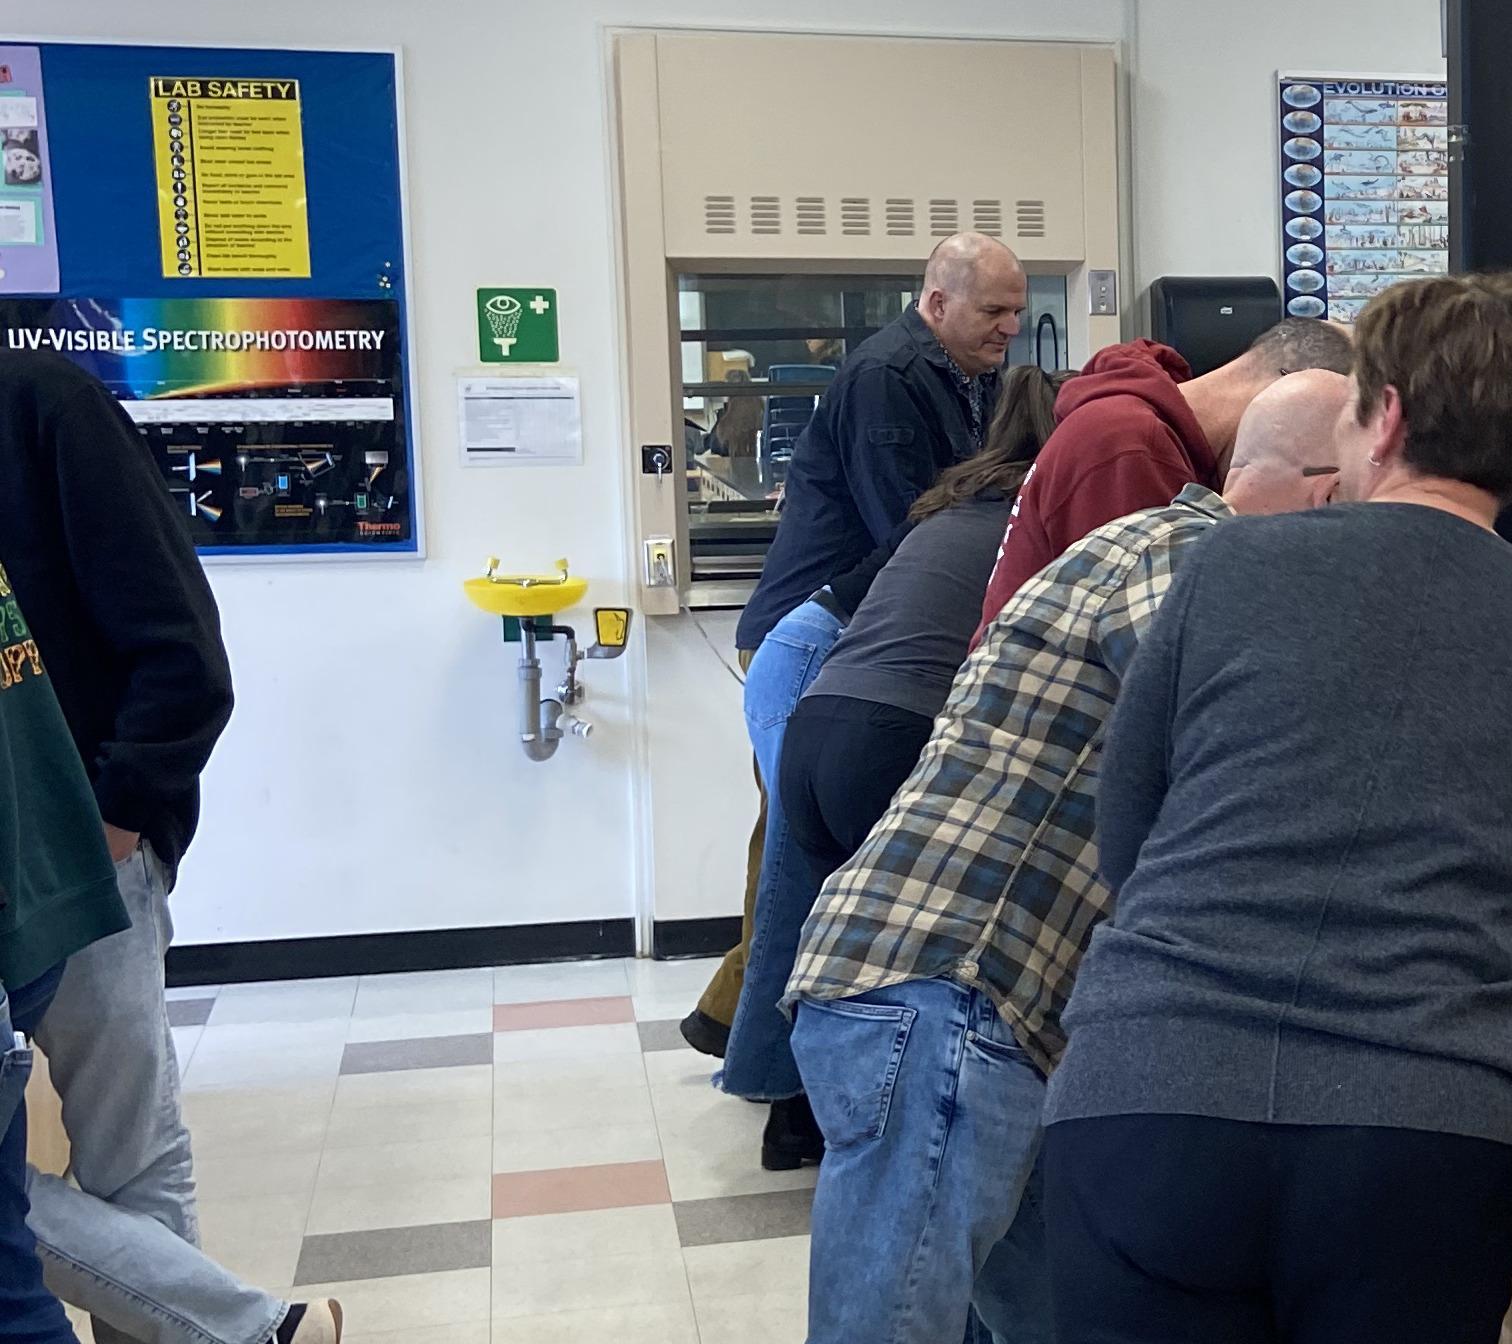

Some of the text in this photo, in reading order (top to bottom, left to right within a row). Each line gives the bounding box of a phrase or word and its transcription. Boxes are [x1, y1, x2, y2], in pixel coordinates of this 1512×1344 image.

[157, 79, 290, 99] LAB SAFETY
[1324, 83, 1427, 96] EVOLUTION
[8, 328, 385, 351] UV-VISIBLE SPECTROPHOTOMETRY
[357, 521, 400, 531] Thermo
